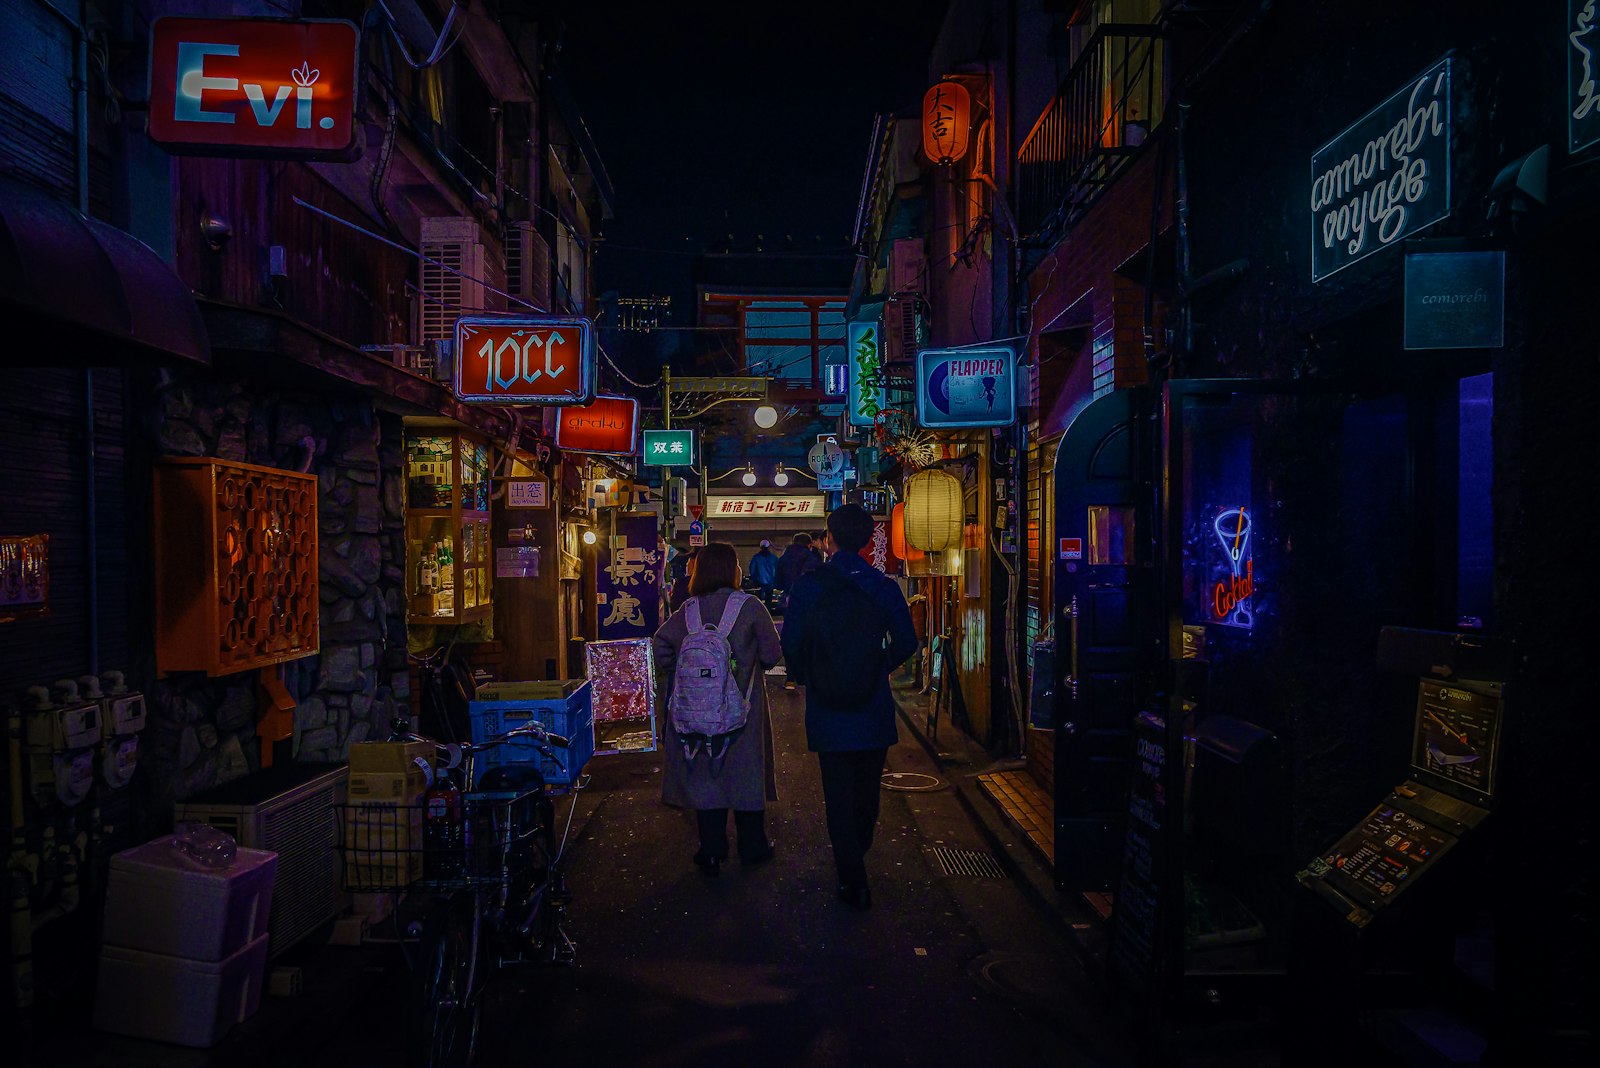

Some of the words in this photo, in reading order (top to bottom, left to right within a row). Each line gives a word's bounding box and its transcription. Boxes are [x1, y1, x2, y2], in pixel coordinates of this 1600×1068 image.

[174, 42, 335, 130] Evi.
[927, 87, 953, 141] 大吉
[1310, 72, 1446, 213] comorebi
[1323, 158, 1428, 256] voyage
[1421, 288, 1488, 305] comorebi
[477, 331, 566, 391] 10CC
[951, 358, 1004, 376] FLAPPER
[811, 453, 841, 463] ROCKET
[720, 500, 811, 513] 新宿ゴールデン街
